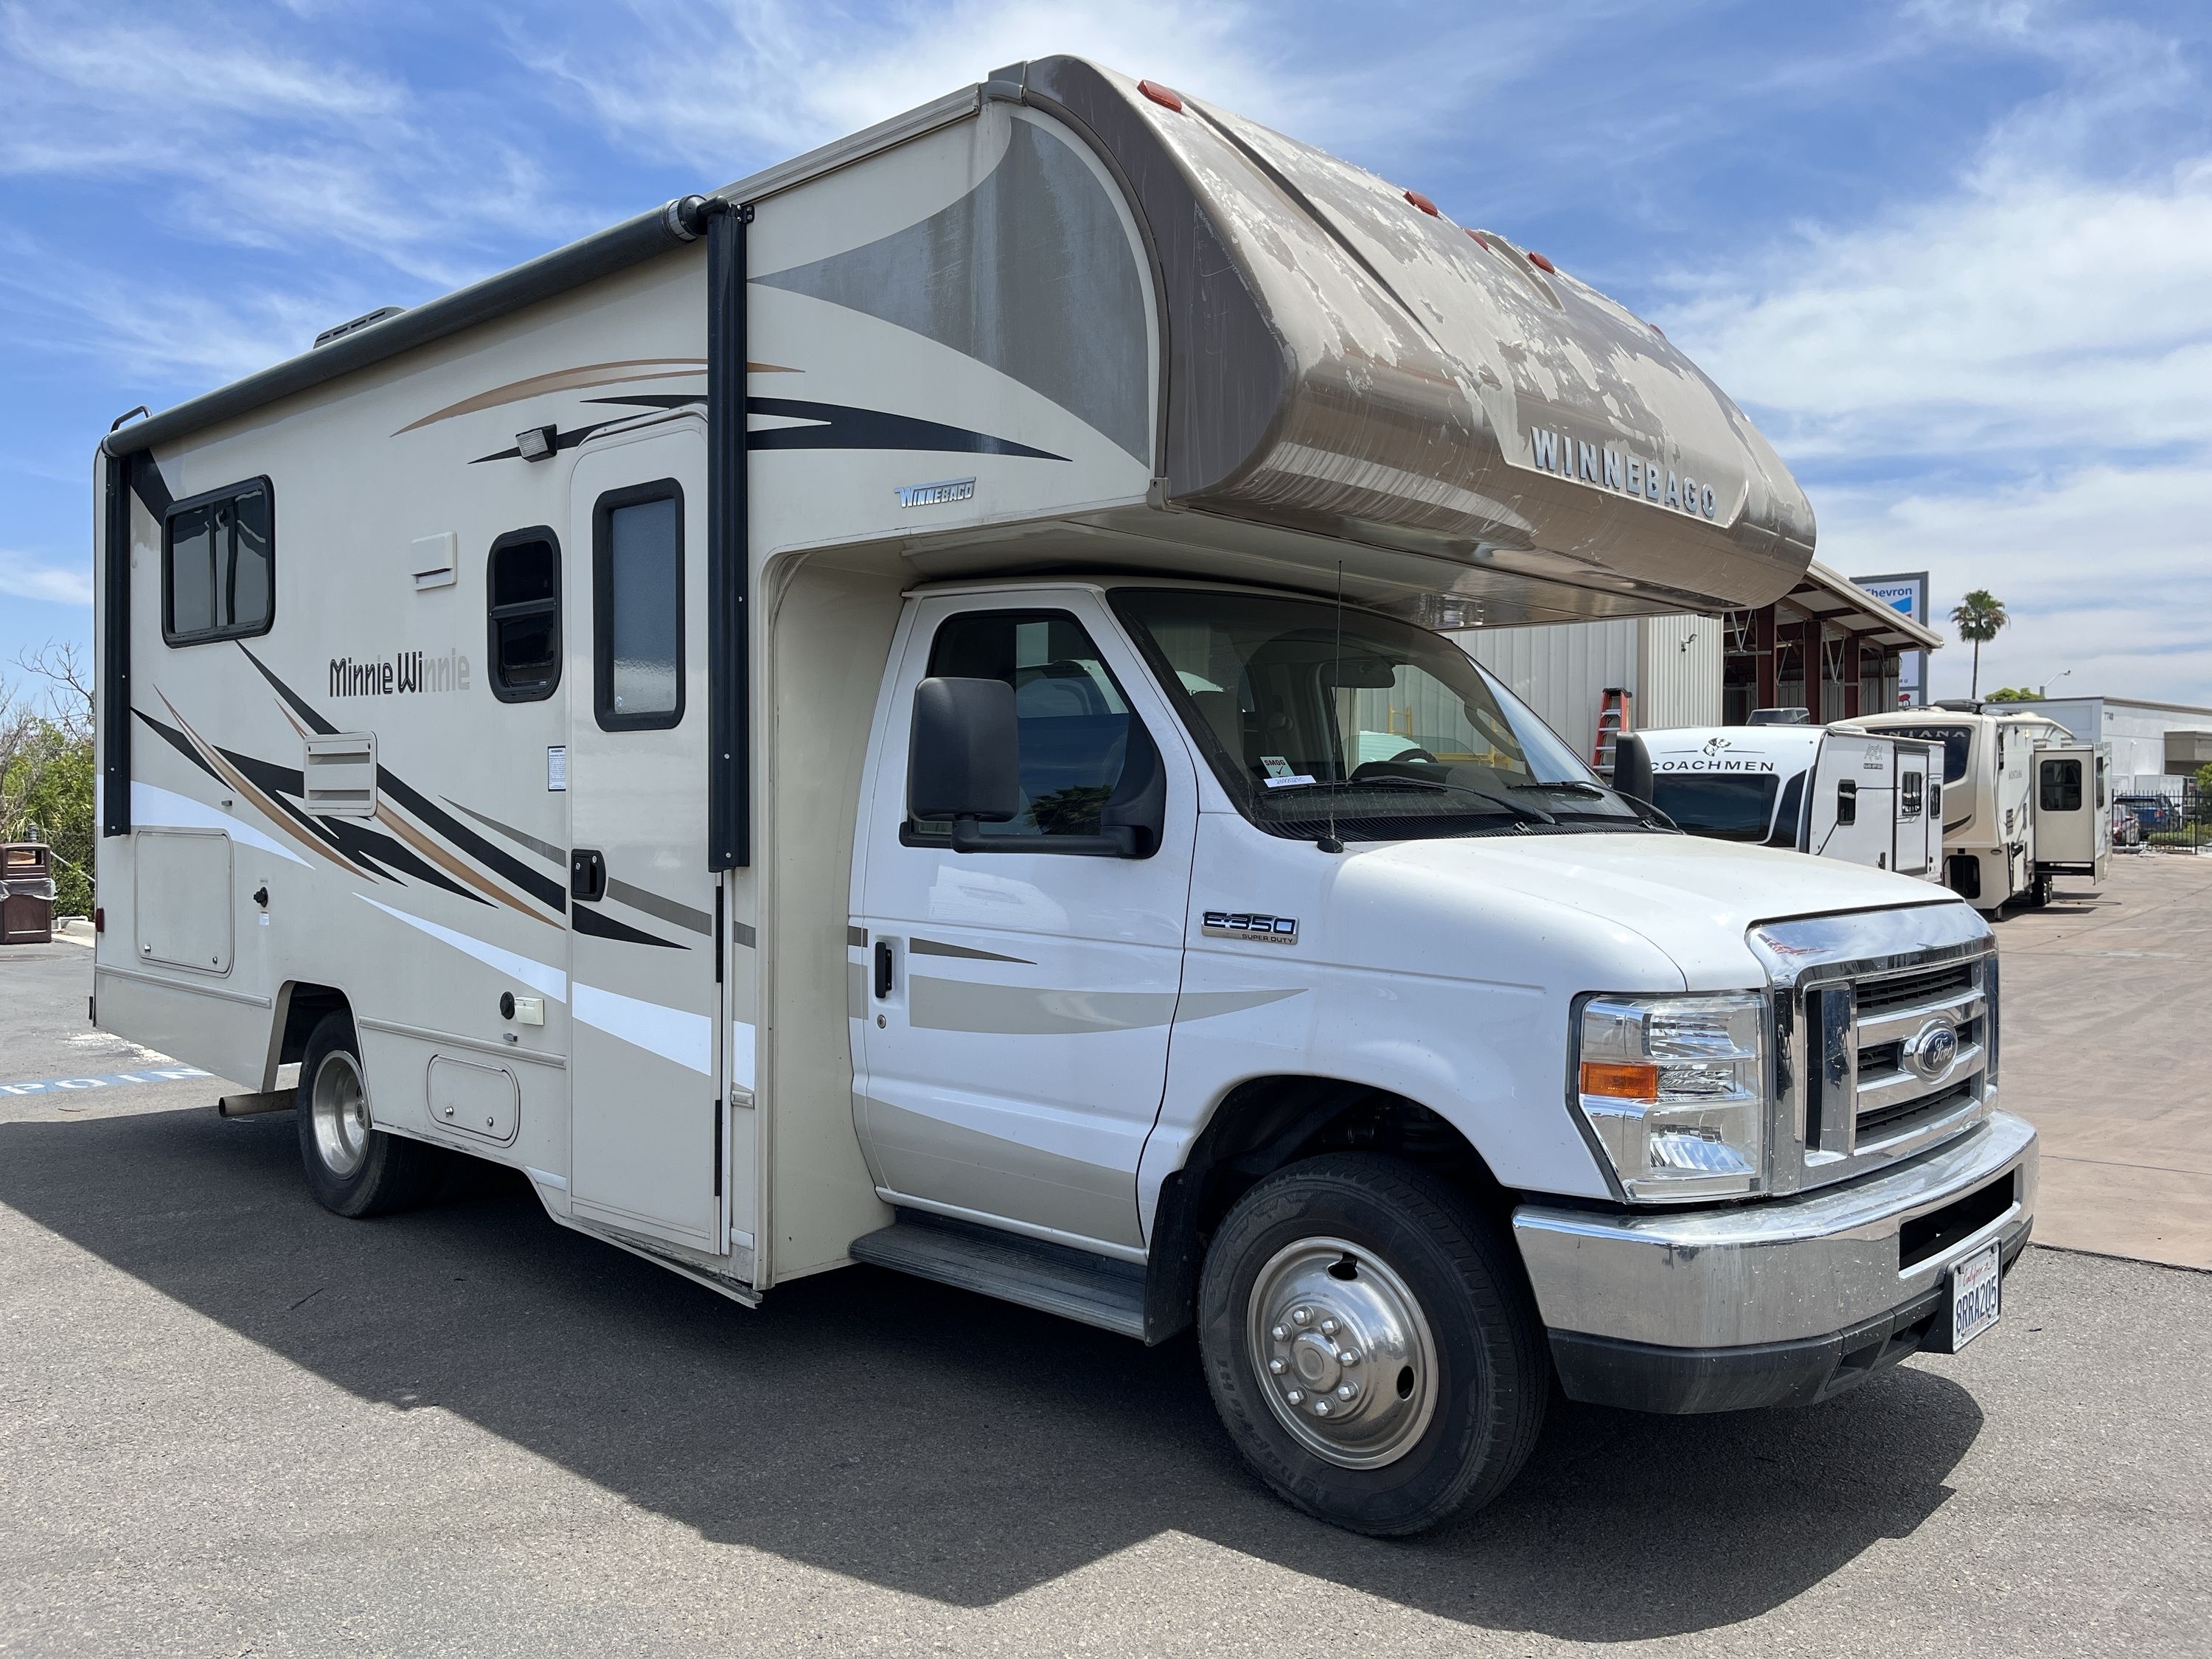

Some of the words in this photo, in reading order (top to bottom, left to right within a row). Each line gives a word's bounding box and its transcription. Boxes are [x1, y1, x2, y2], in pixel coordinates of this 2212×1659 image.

[1531, 425, 1717, 519] WINNEBAGO
[894, 478, 975, 508] WINNEBAGO
[1865, 588, 1912, 597] hevron
[330, 654, 394, 698] Minnie
[397, 648, 470, 694] Winnie
[1880, 730, 1966, 738] NTANA
[1651, 760, 1774, 772] COACHMEN
[1242, 933, 1269, 942] SUPER
[1933, 1036, 1953, 1063] Ford
[1956, 1274, 1997, 1334] 8RRA205
